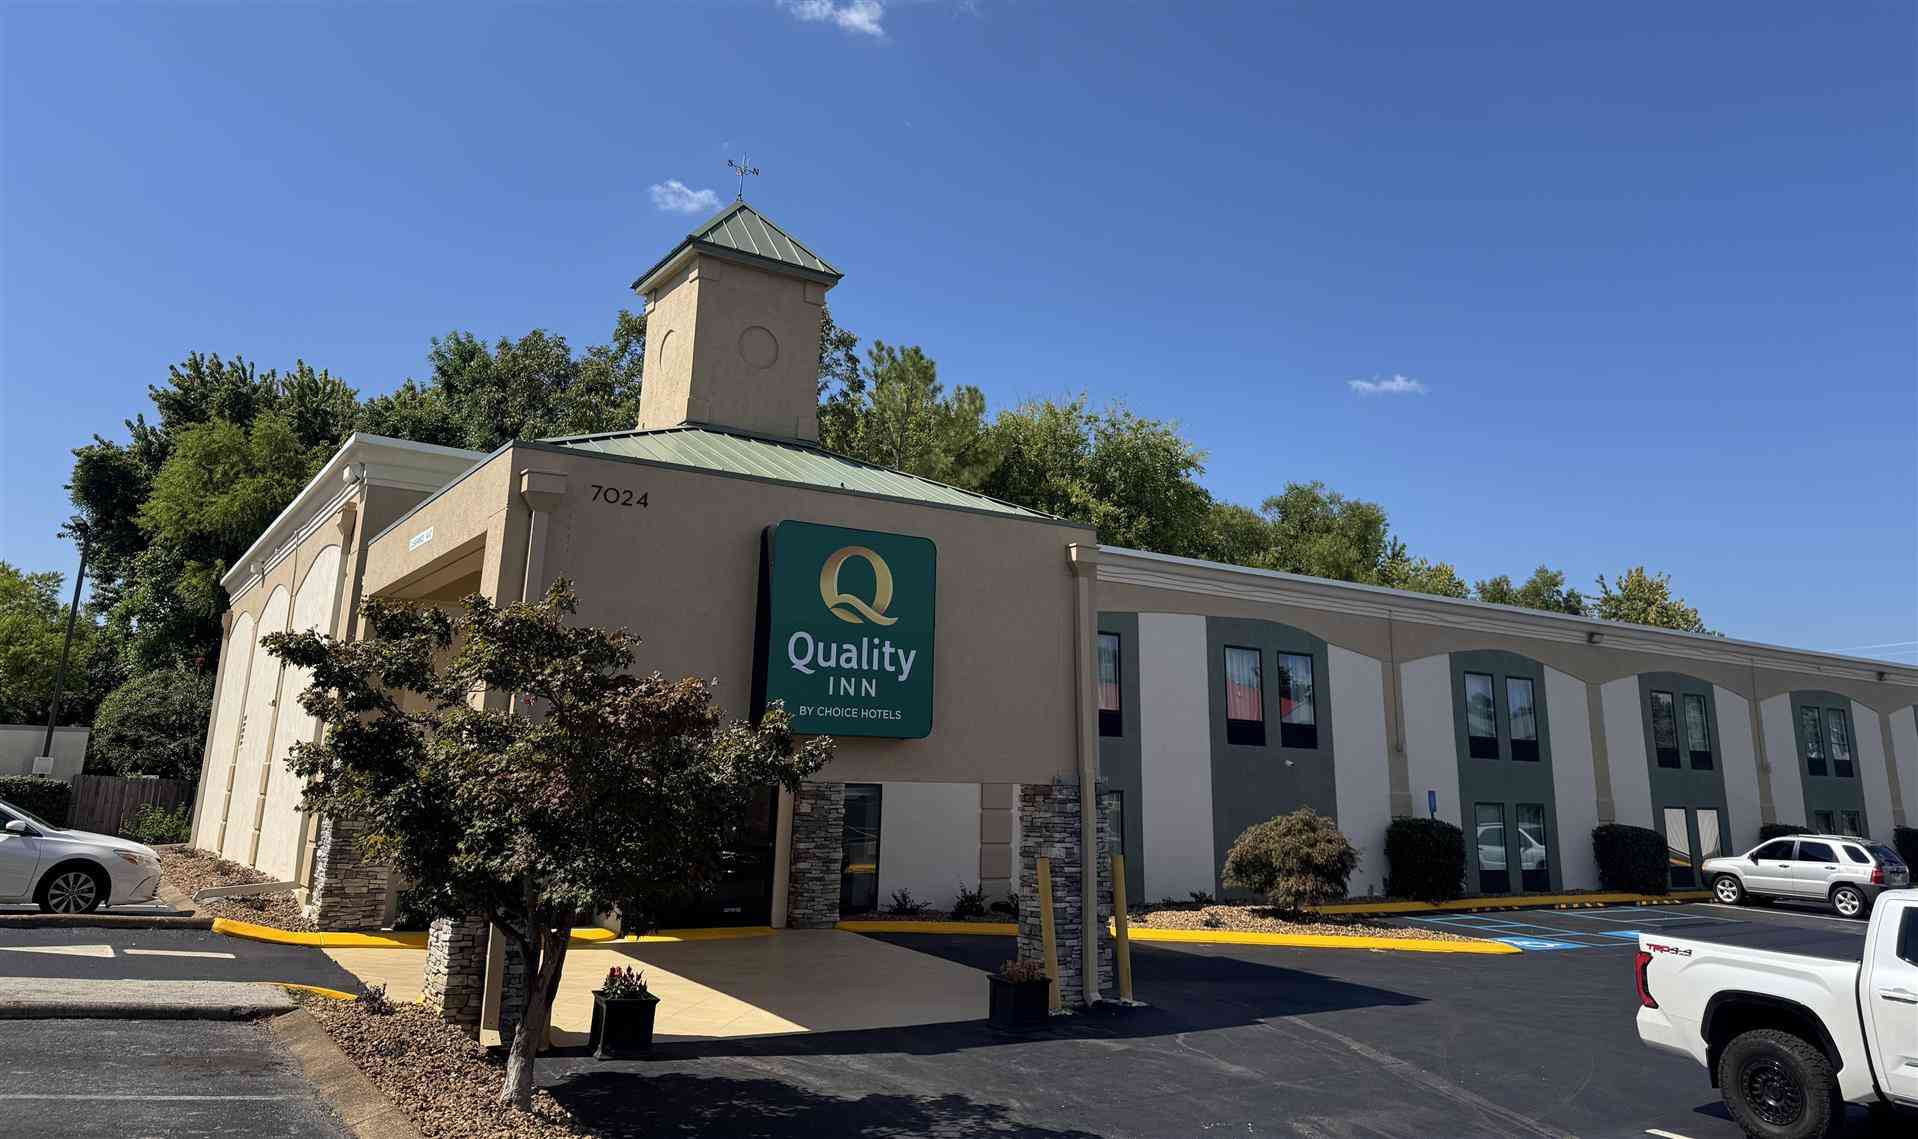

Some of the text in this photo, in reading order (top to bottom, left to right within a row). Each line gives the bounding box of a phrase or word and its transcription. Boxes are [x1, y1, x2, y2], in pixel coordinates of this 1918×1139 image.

[591, 484, 649, 509] 7024
[819, 545, 899, 626] Q
[787, 631, 917, 682] Quality
[828, 676, 877, 697] INN
[799, 705, 902, 720] BY CHOICE HOTELS
